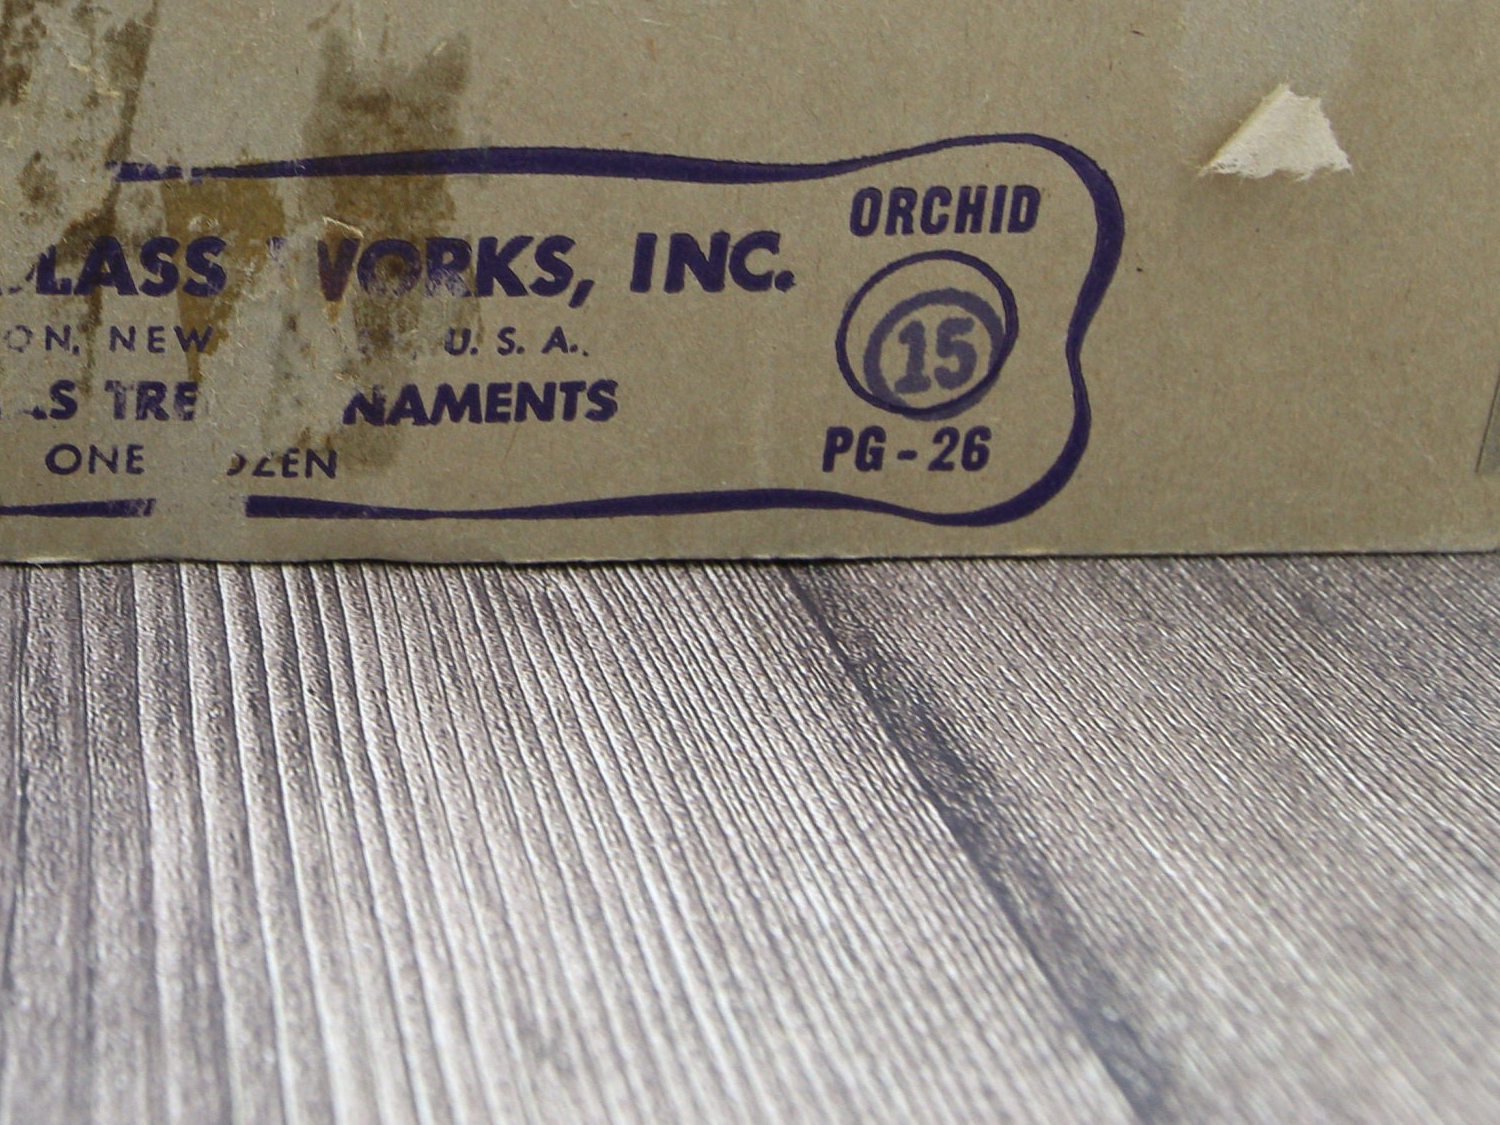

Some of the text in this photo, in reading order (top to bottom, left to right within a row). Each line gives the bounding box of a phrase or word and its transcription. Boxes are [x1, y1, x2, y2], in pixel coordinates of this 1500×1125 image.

[850, 185, 1041, 236] ORCHID
[629, 230, 796, 293] INC.
[109, 325, 213, 354] NEW
[894, 317, 978, 394] 15
[104, 380, 199, 421] TRE
[342, 379, 620, 426] NAMENTS
[45, 443, 145, 475] ONE
